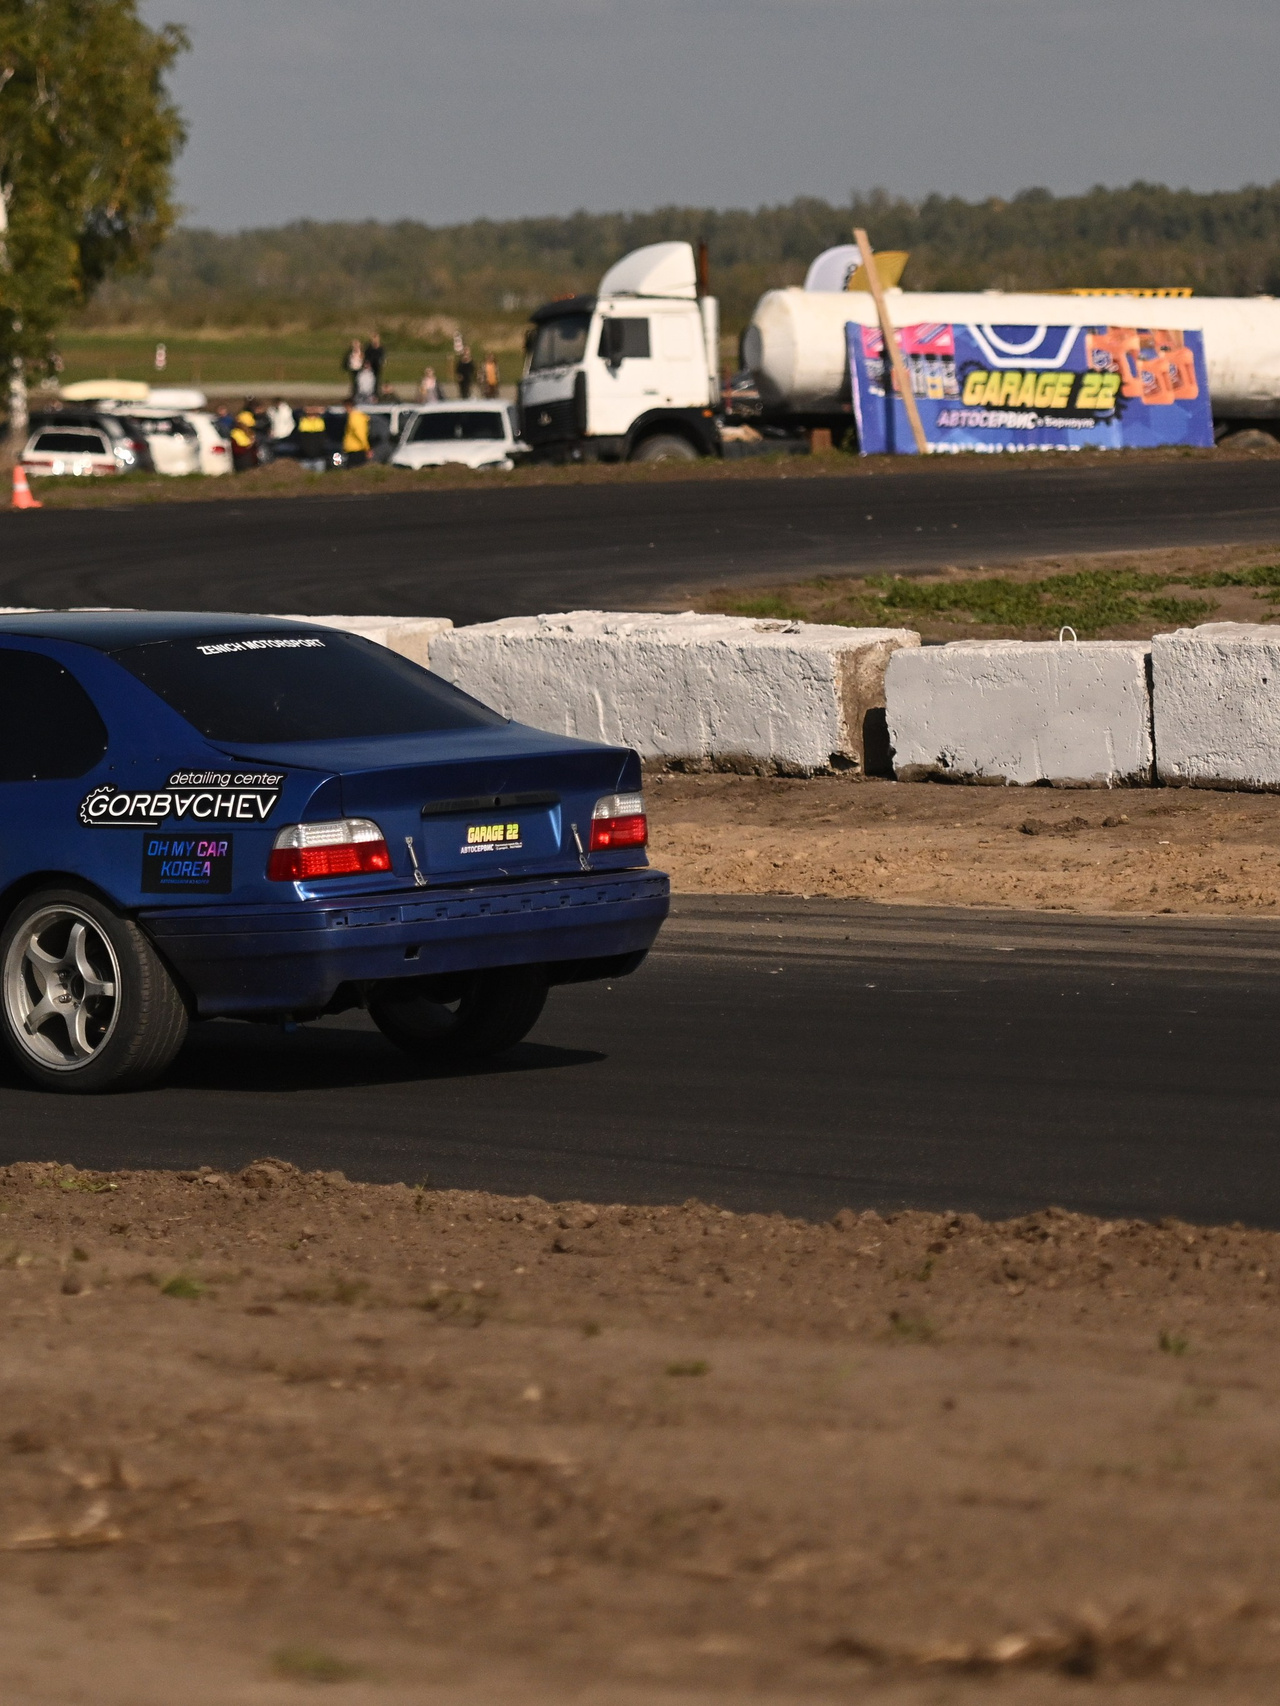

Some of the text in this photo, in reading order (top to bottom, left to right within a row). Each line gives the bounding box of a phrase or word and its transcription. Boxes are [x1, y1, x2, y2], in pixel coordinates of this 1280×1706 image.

[961, 370, 1074, 409] GARAGE
[1075, 371, 1121, 410] 22
[936, 409, 1038, 430] АВТОСЕРВИС
[196, 639, 326, 656] ZENICH MOTORSPORT
[169, 771, 284, 787] detailing center
[467, 823, 519, 843] GARAGE 22
[147, 840, 228, 857] OH MY CAR
[460, 844, 494, 854] АВТОСЕРВИС
[160, 861, 211, 877] KOREA
